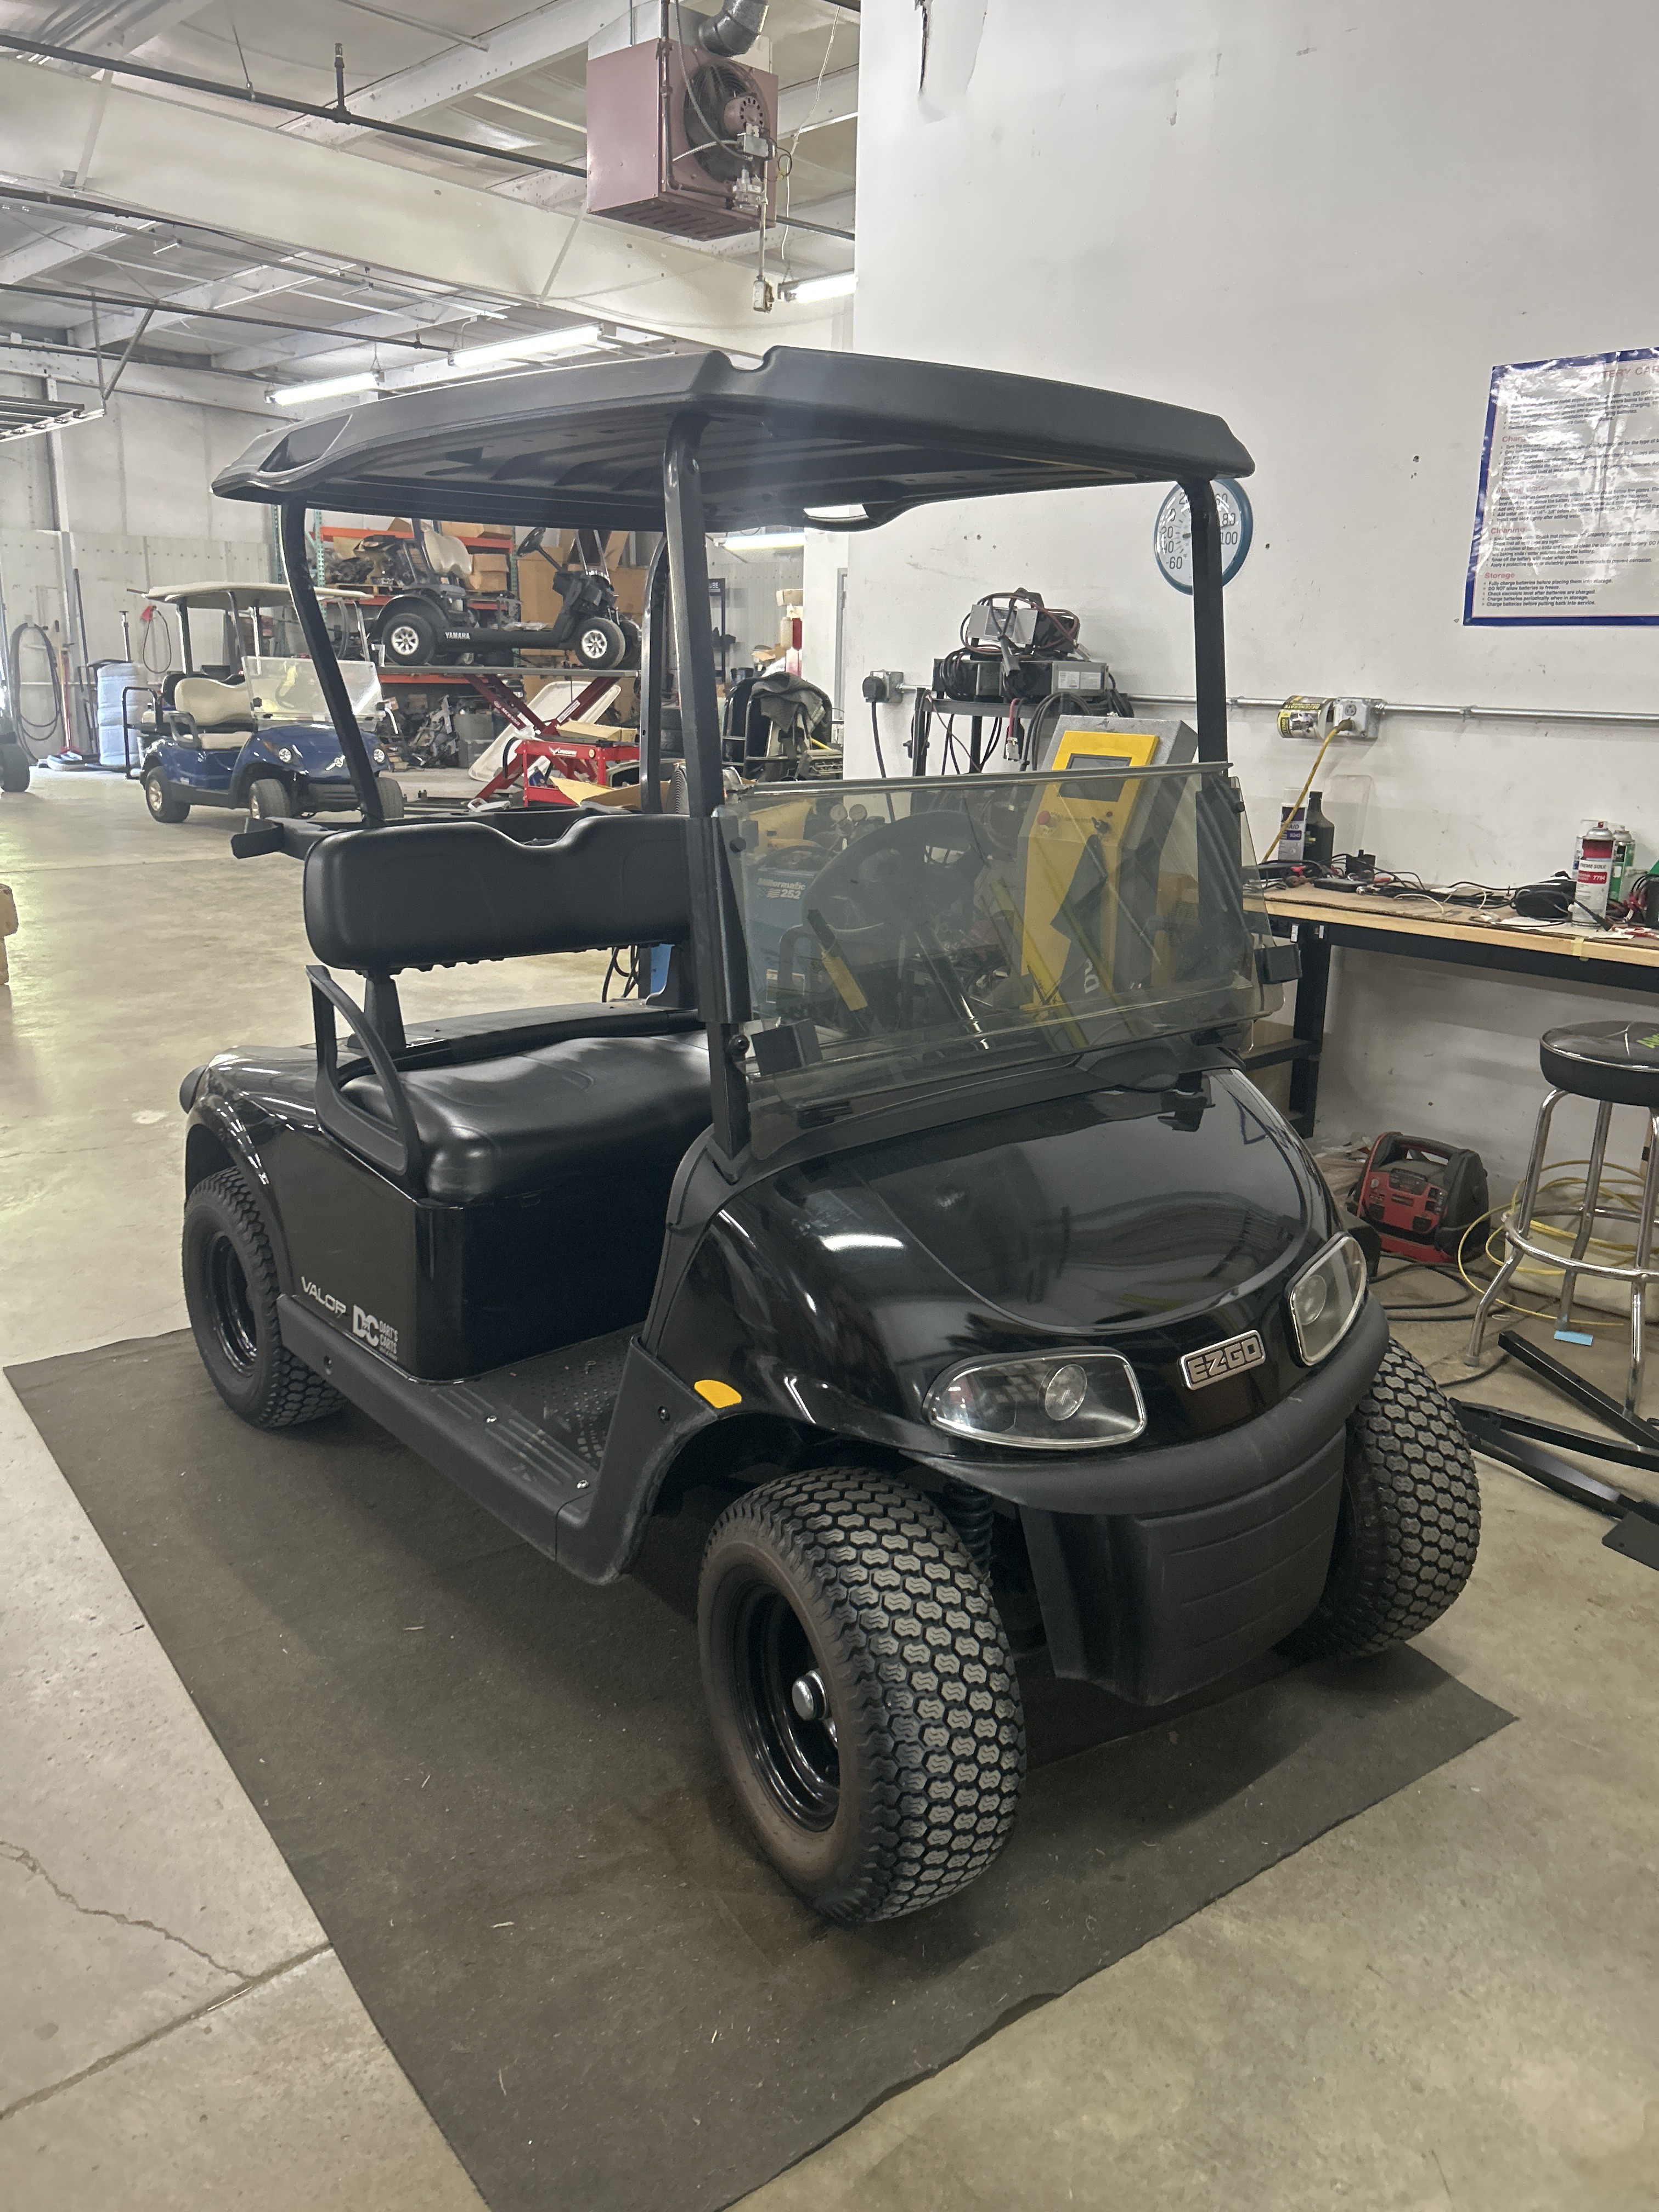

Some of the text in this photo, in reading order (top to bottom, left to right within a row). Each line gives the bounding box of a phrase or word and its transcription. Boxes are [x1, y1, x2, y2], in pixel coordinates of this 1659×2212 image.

[1222, 512, 1236, 526] 80
[1221, 532, 1238, 545] 100
[757, 878, 806, 890] Millermatic
[780, 889, 802, 900] 252
[301, 1276, 346, 1319] VALOR
[352, 1304, 379, 1347] DC
